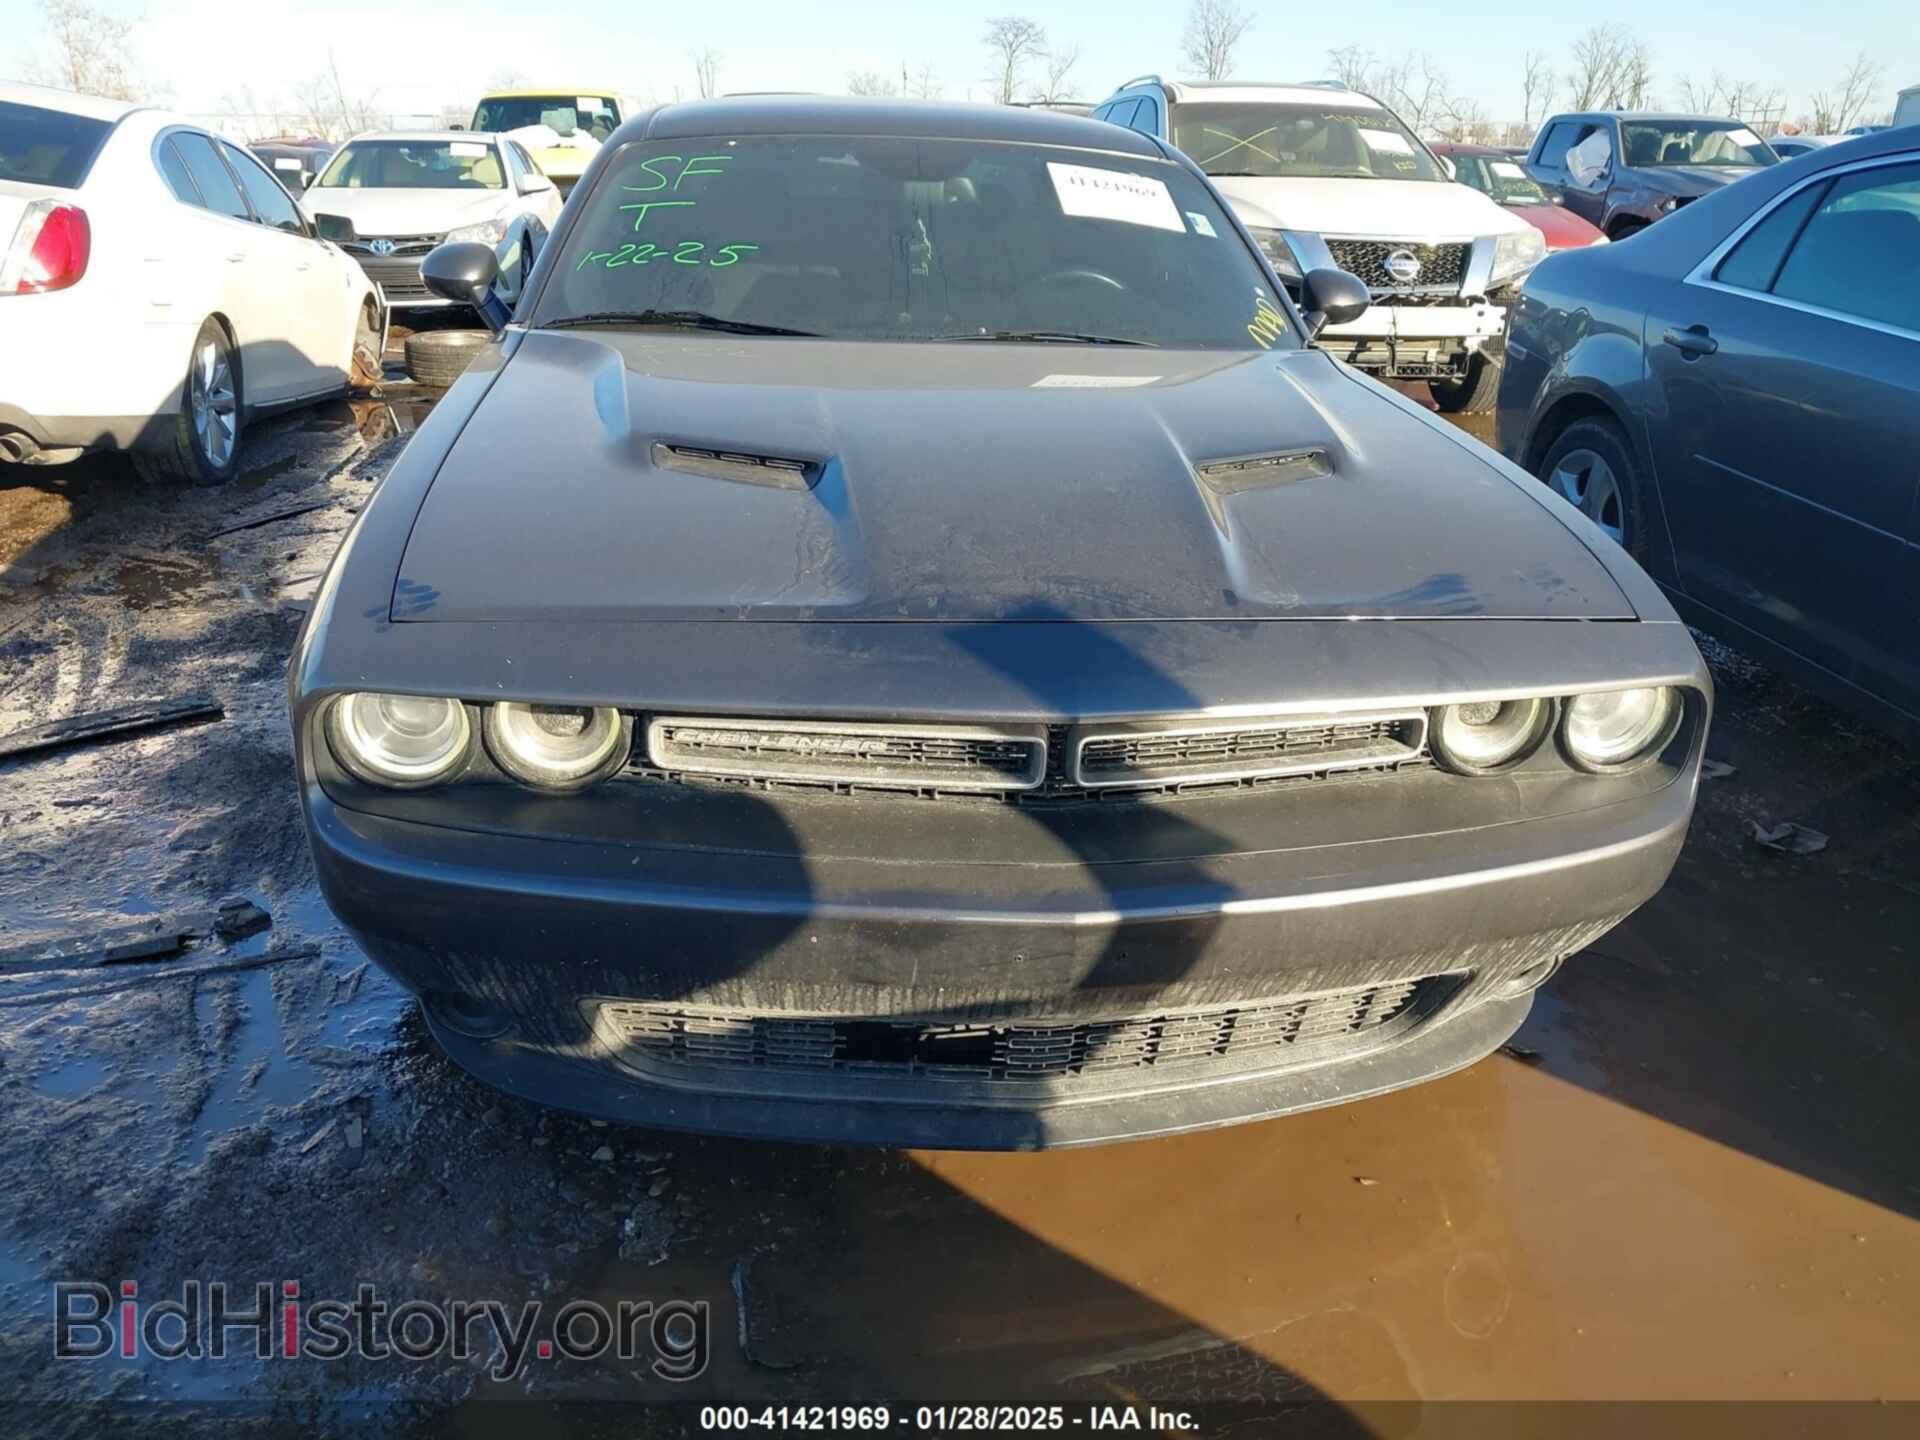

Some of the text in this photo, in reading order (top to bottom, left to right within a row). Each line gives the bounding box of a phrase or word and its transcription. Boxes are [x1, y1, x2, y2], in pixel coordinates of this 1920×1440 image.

[621, 155, 734, 191] SF
[619, 201, 697, 231] T
[576, 241, 760, 272] 1-22-25
[674, 728, 888, 752] CHALLENGER
